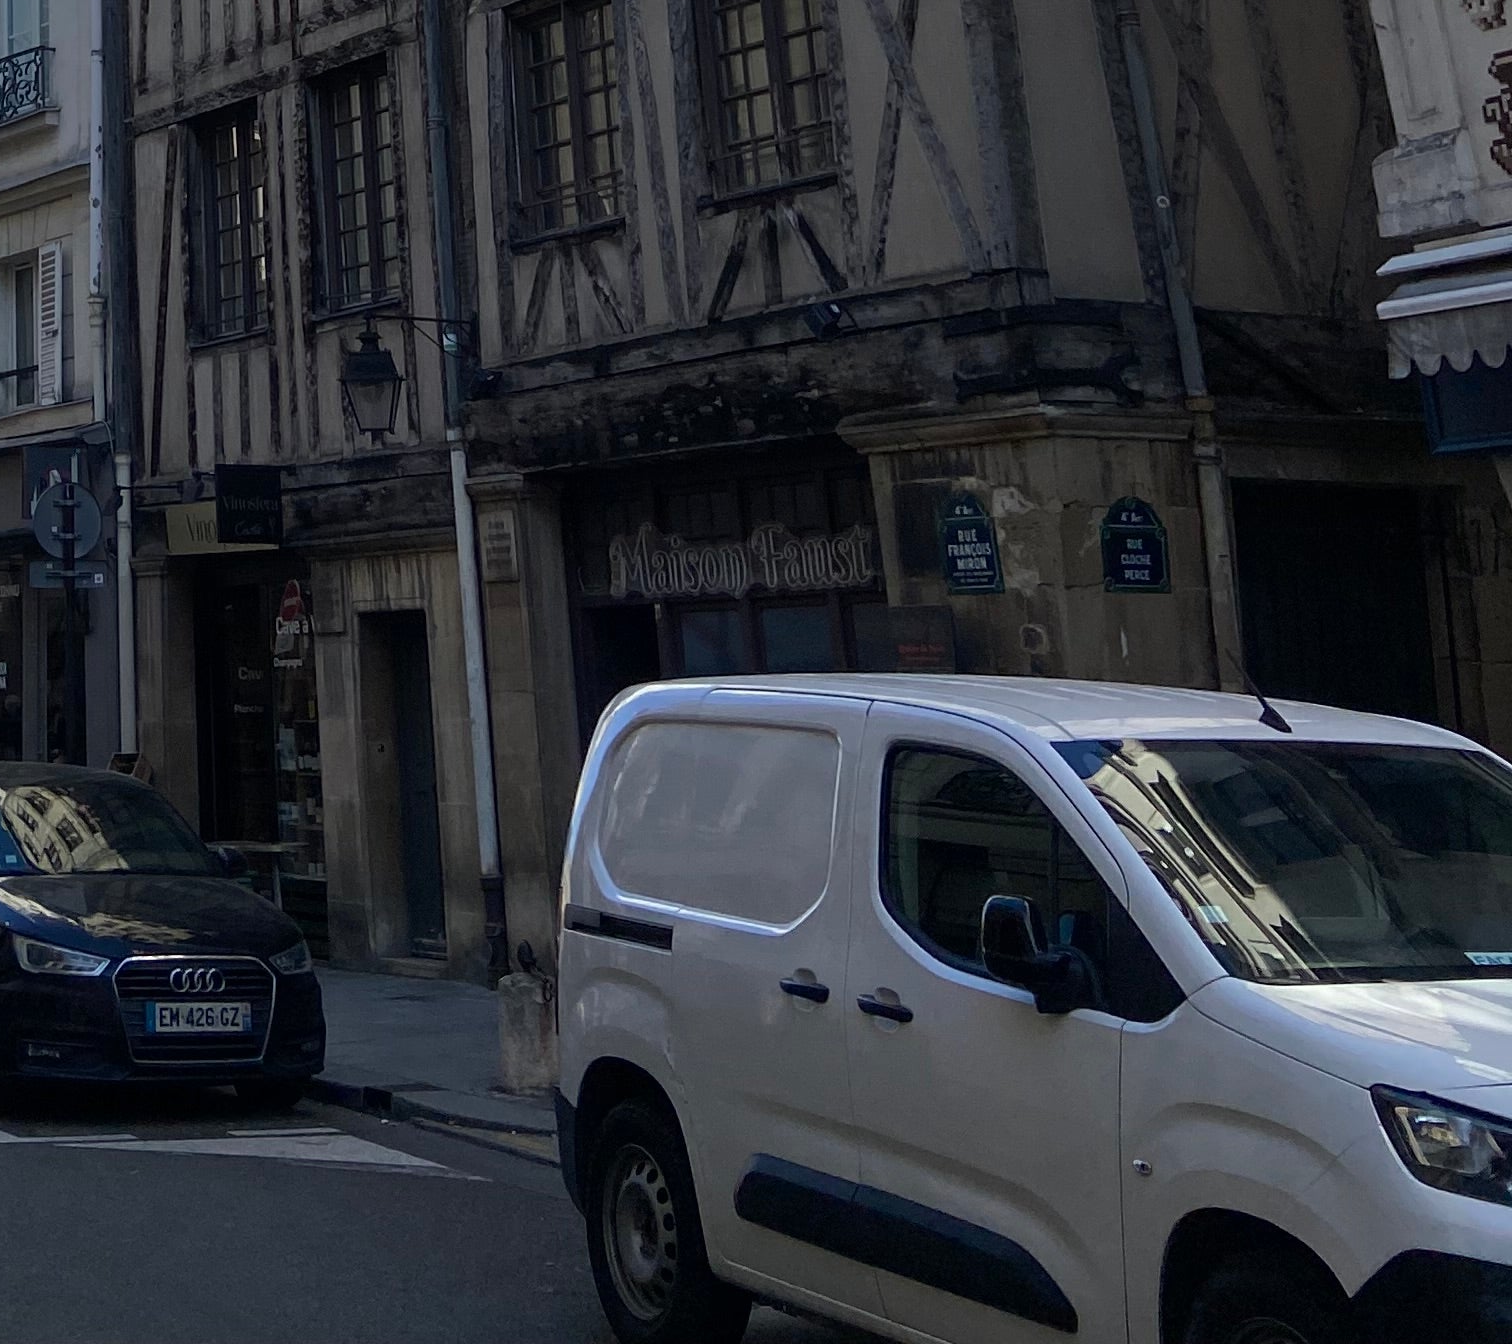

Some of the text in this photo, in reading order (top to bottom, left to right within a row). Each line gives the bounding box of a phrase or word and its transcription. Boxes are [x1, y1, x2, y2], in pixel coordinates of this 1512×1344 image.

[957, 528, 977, 543] RUE
[609, 522, 872, 599] Maison Faust
[957, 557, 987, 570] MIRON
